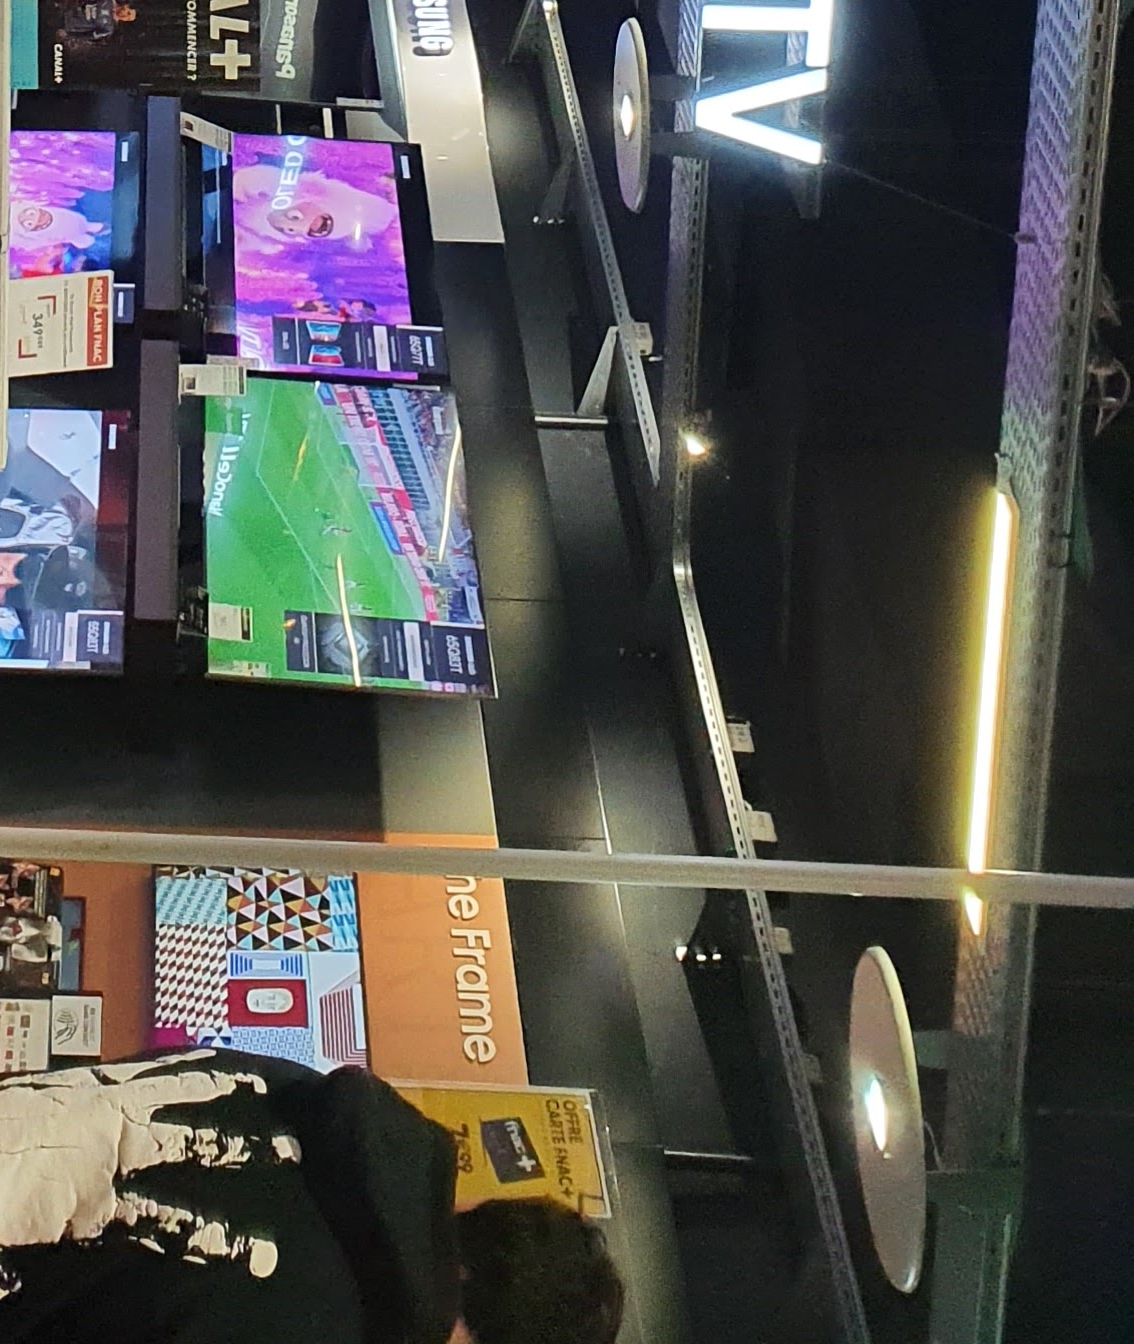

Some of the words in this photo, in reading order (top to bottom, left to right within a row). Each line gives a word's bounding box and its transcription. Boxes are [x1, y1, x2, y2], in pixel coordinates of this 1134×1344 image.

[53, 43, 63, 84] CANAL+
[186, 73, 197, 81] ?
[93, 304, 103, 333] PLAN
[92, 333, 102, 364] FNAC
[446, 874, 483, 919] he
[450, 927, 497, 1063] Frame
[546, 1100, 565, 1145] CARTE
[563, 1100, 582, 1144] OFFRE
[553, 1147, 574, 1199] FNAC+
